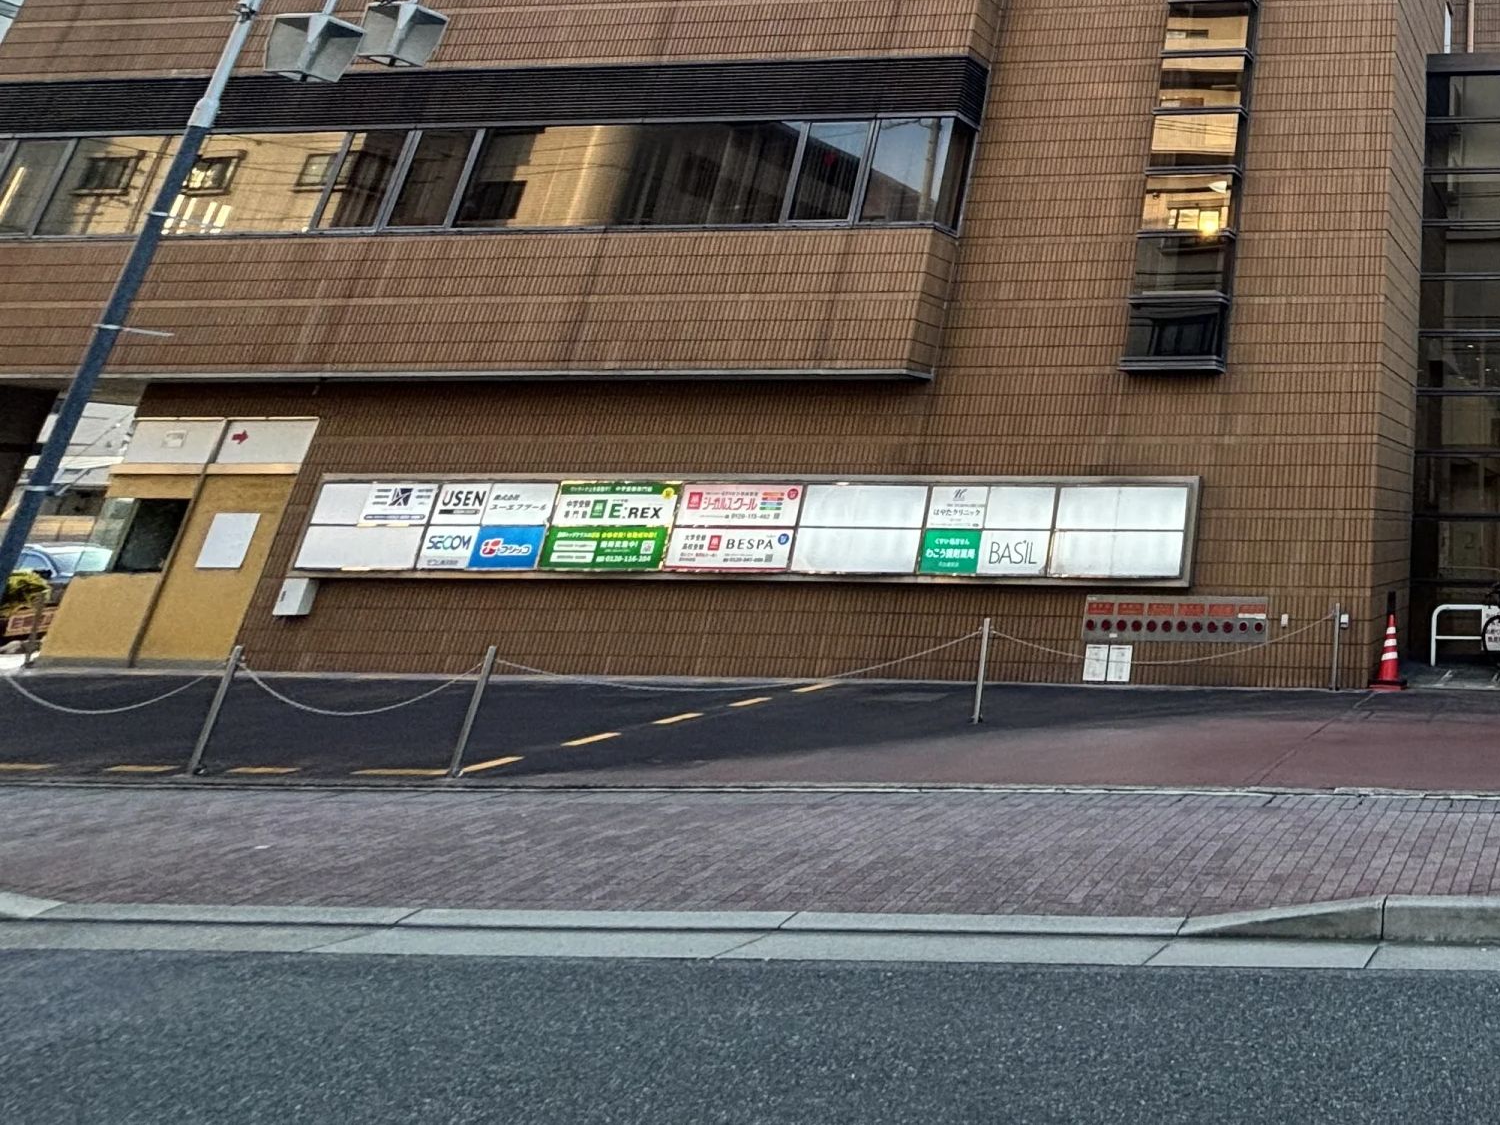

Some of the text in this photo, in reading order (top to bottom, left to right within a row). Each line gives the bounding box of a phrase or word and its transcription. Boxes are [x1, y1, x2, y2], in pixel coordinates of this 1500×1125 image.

[442, 490, 487, 507] USEN
[426, 535, 472, 550] SECOM
[726, 538, 774, 550] BESPA
[988, 541, 1037, 565] BASIL
